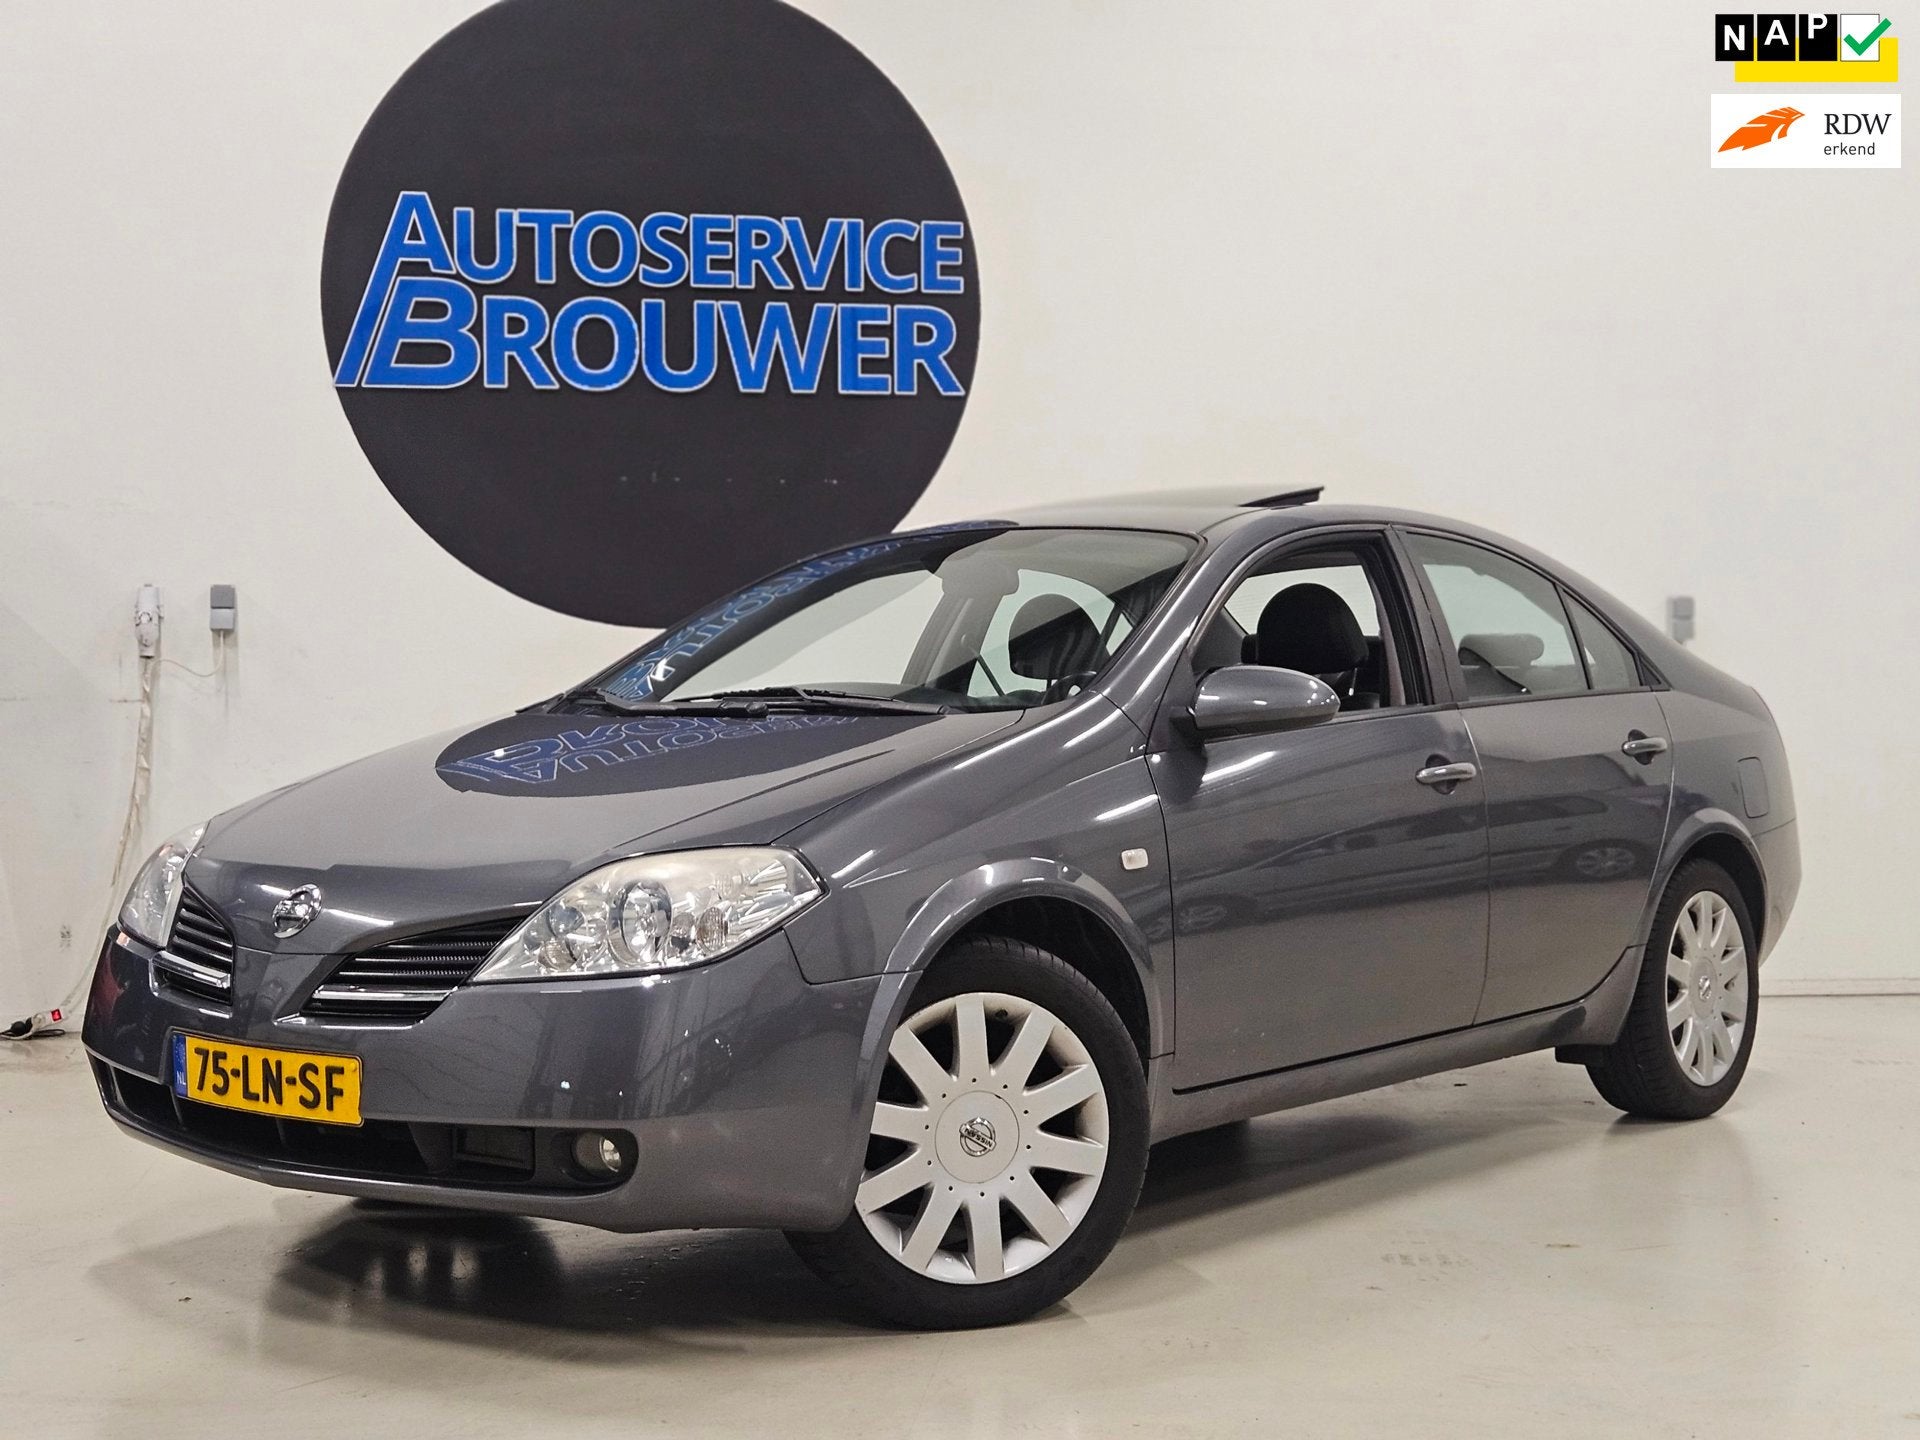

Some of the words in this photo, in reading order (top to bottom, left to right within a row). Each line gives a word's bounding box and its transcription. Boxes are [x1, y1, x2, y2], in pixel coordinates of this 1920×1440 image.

[362, 277, 965, 396] BROUWER
[176, 1071, 187, 1085] NL
[194, 1047, 345, 1111] 75-LN-SF
[964, 1128, 994, 1148] NISSAN
